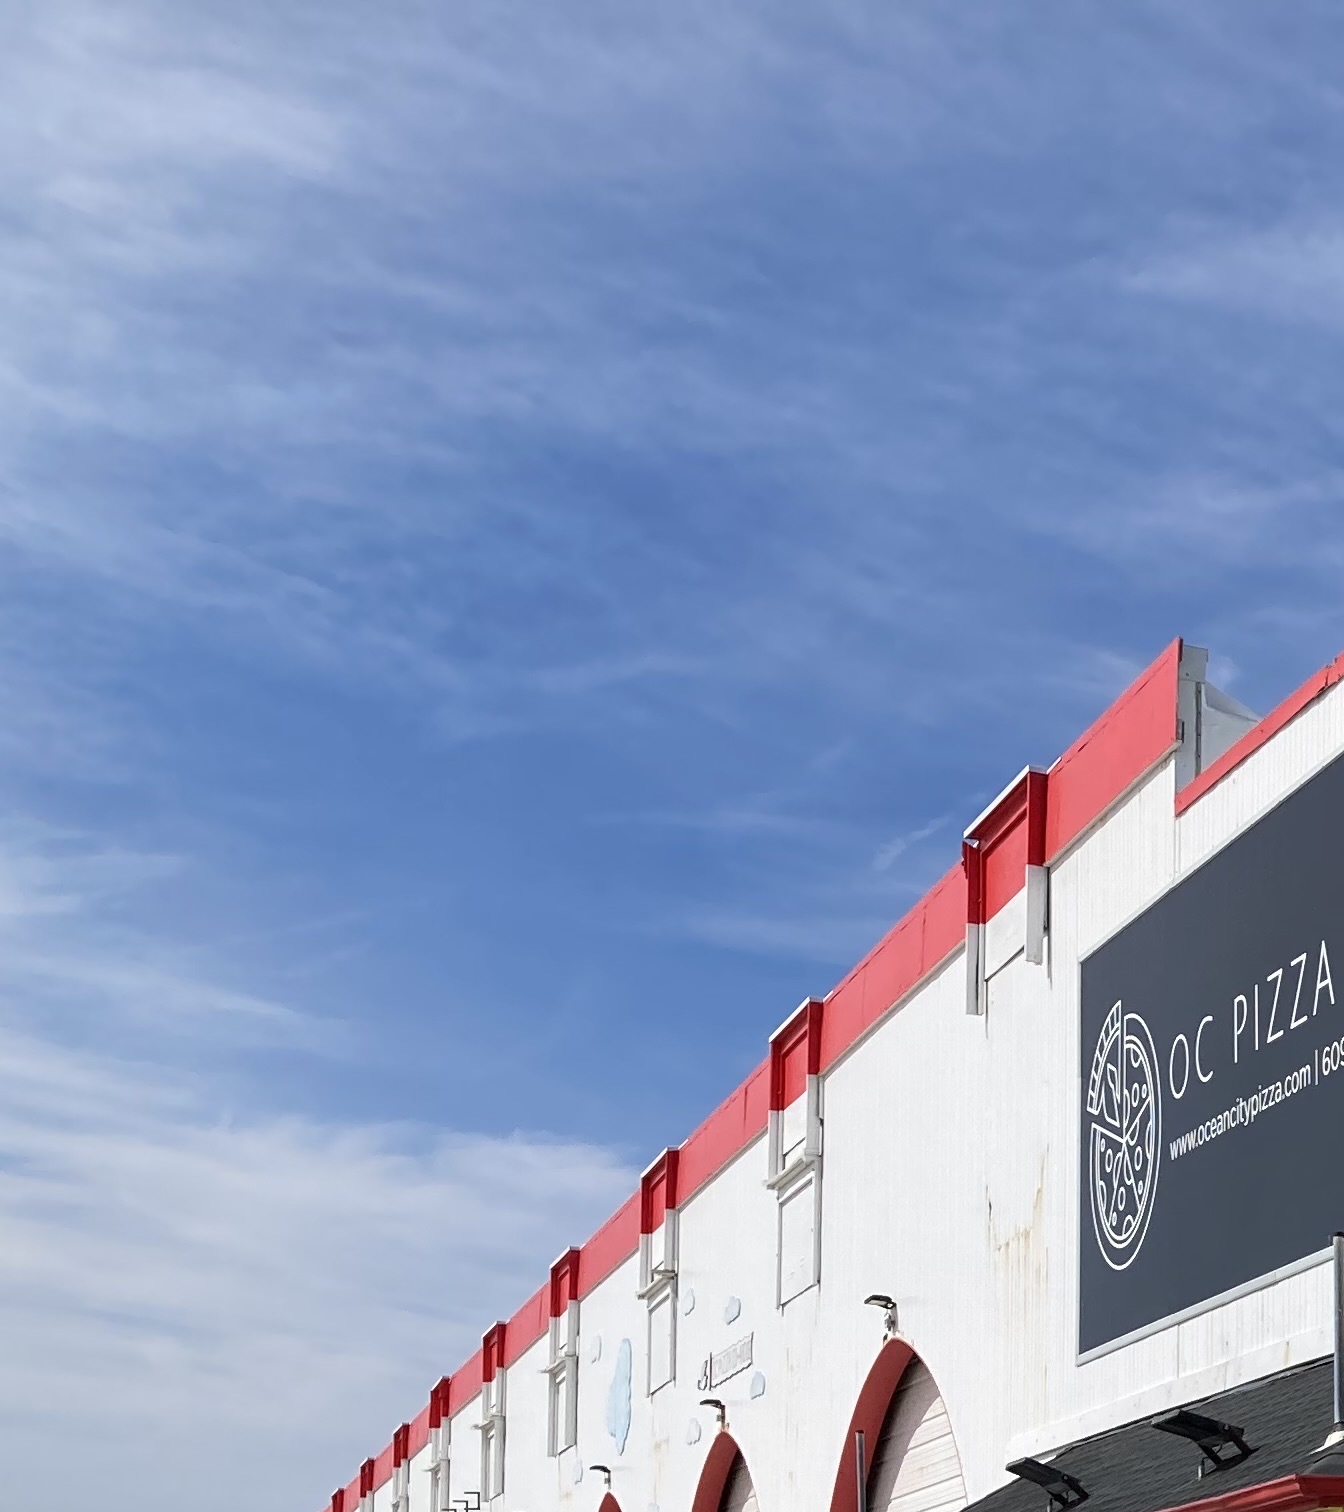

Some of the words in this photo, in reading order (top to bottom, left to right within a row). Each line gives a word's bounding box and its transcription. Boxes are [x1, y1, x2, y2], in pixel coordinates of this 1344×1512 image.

[1169, 1015, 1213, 1099] OC
[1234, 940, 1335, 1063] PIZZA
[1169, 1064, 1311, 1160] www.oceancitypizza.com
